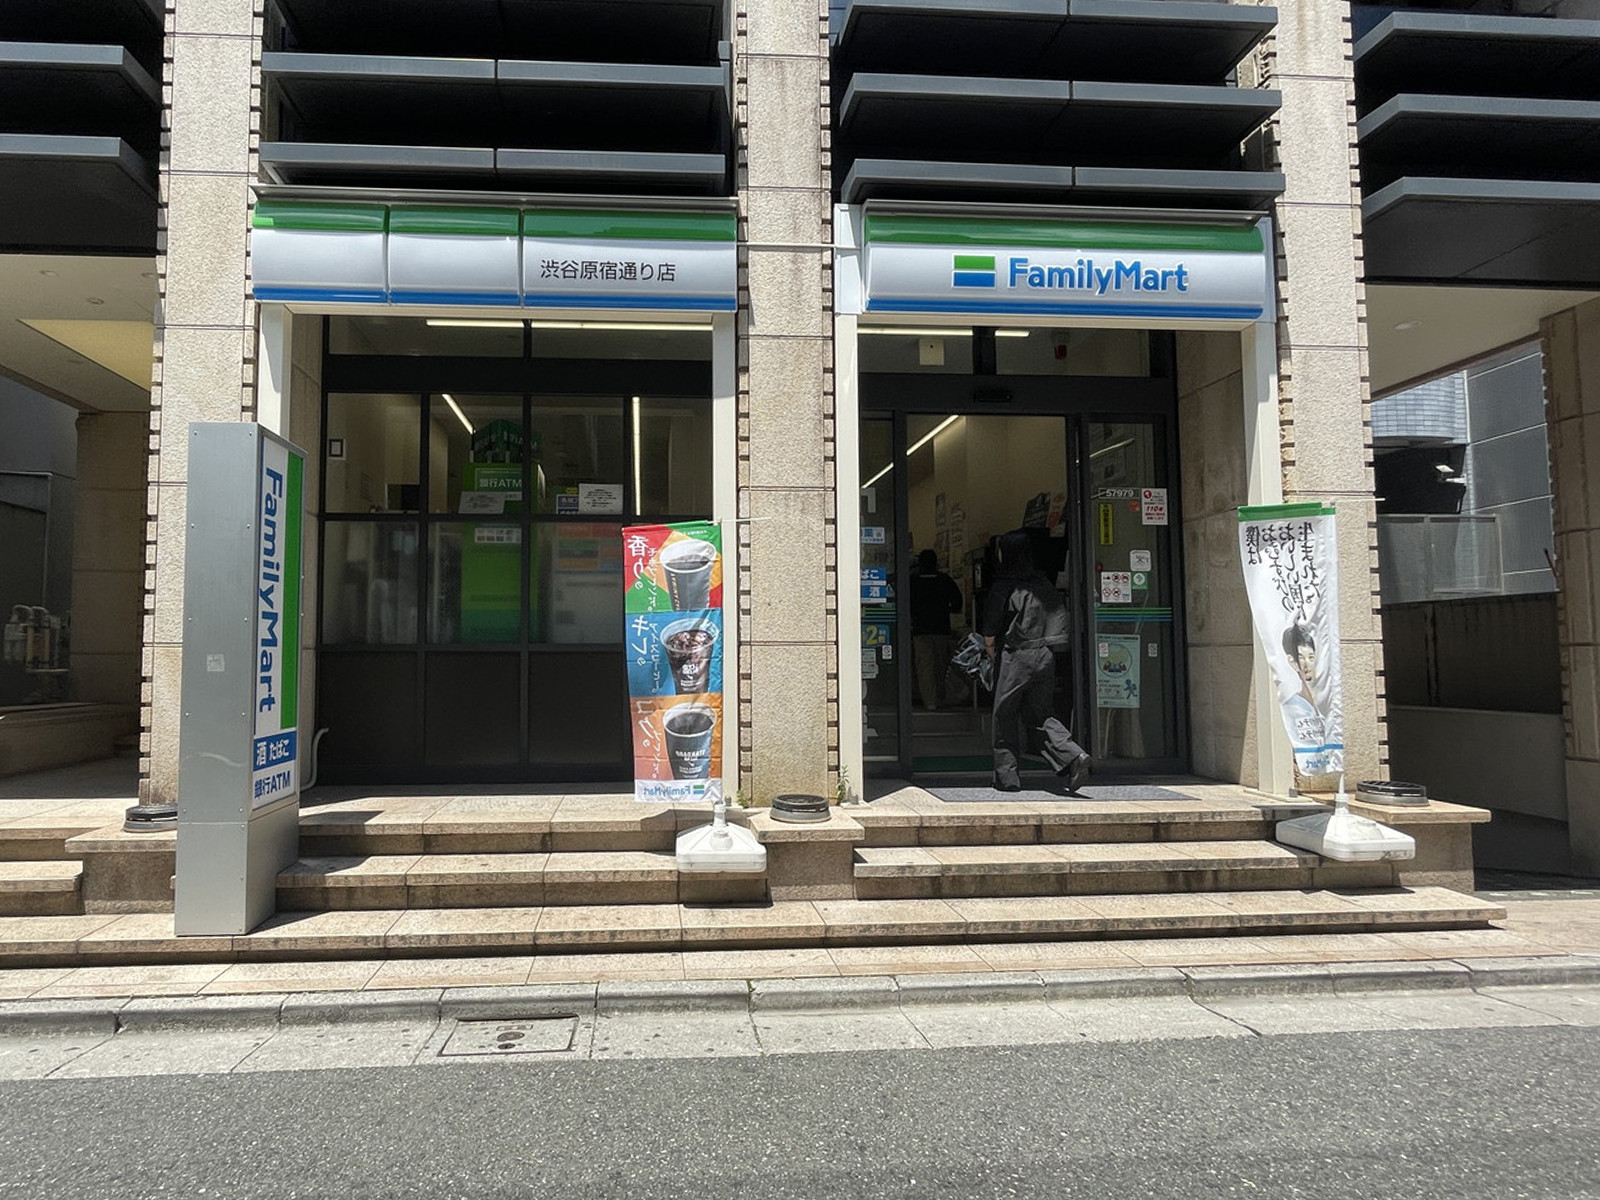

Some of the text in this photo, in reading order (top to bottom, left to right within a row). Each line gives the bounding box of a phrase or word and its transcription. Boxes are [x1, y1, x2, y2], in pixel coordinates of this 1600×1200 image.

[540, 259, 676, 282] 渋谷原宿通り店
[1008, 257, 1189, 295] FamilyMart
[257, 467, 284, 713] FamilyMart
[256, 738, 290, 766] 酒 たばこ
[254, 770, 291, 798] 銀行ATM
